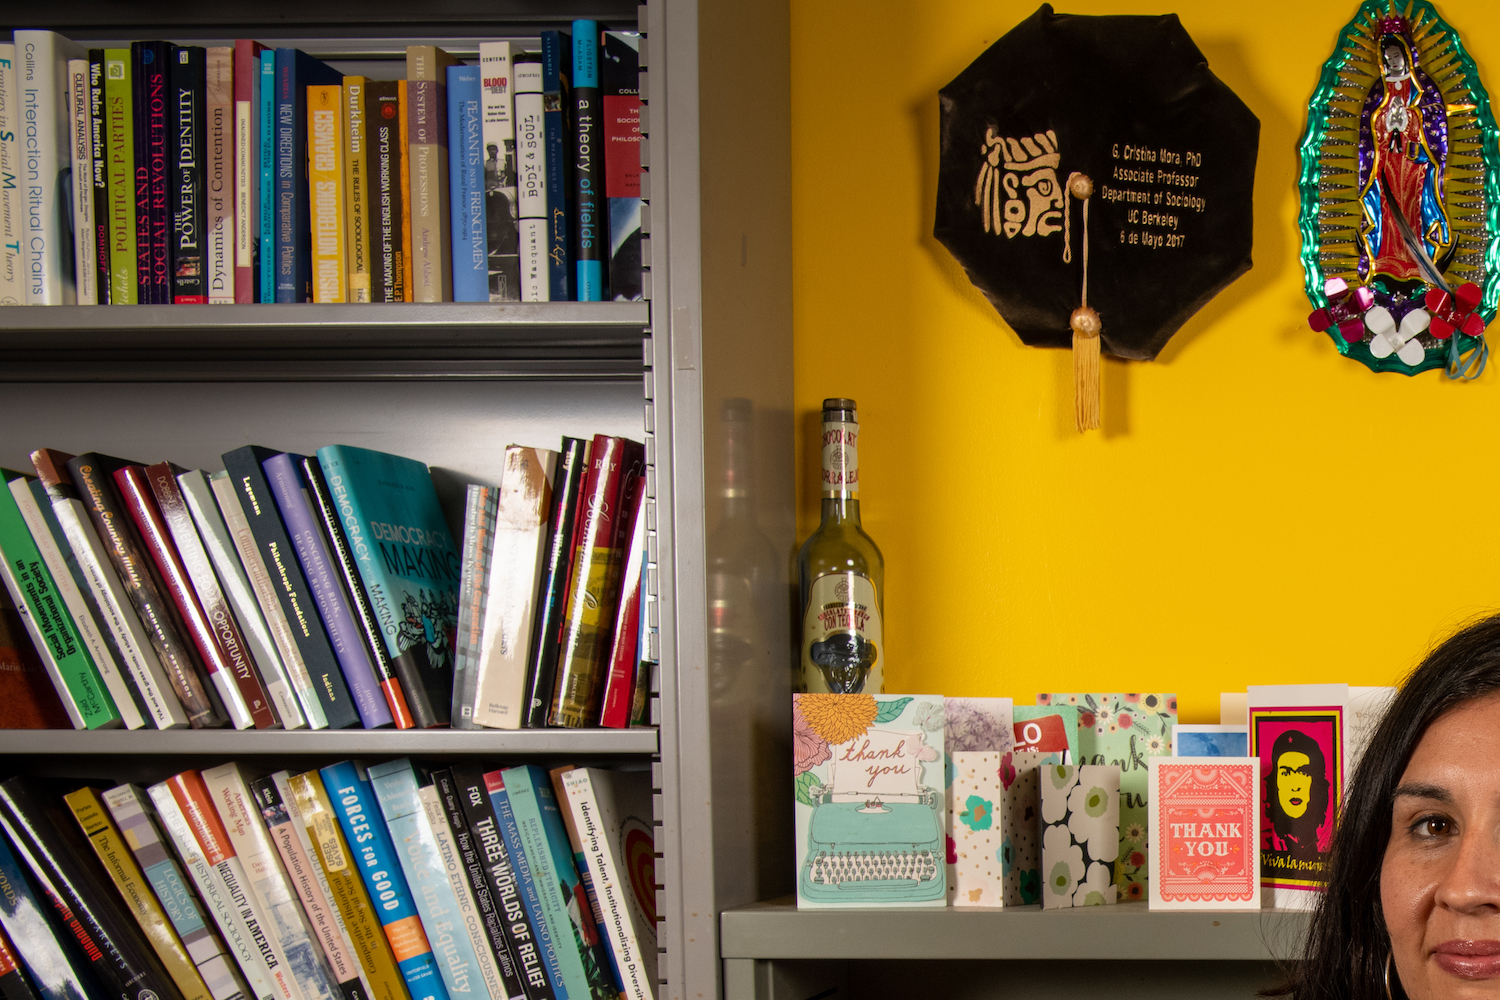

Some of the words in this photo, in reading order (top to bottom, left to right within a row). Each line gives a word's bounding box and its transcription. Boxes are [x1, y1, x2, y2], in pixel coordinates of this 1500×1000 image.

[24, 42, 34, 82] Collins
[482, 56, 507, 64] CENTENO
[484, 78, 508, 88] BLOOD
[578, 99, 590, 110] a
[25, 88, 41, 181] Interaction
[112, 96, 125, 169] PARTIES
[150, 74, 166, 209] REVOLUTIONS
[578, 112, 594, 175] theory
[1114, 165, 1154, 183] Associate
[1158, 169, 1200, 189] Professor
[1124, 144, 1157, 165] Cristina
[1187, 150, 1202, 167] PhD
[28, 185, 43, 231] Ritual
[136, 166, 149, 211] AND
[580, 177, 596, 199] of
[1102, 185, 1152, 206] Department
[1154, 188, 1164, 204] of
[1166, 190, 1207, 213] Sociology
[114, 177, 128, 252] POLITICAL
[582, 202, 596, 251] fields
[1128, 209, 1140, 224] UC
[1142, 209, 1180, 231] Berkeley
[138, 214, 150, 286] STATES
[153, 215, 166, 286] SOCIAL
[1120, 230, 1126, 244] 6
[1130, 231, 1140, 245] de
[1142, 232, 1164, 250] Mayo
[1166, 234, 1186, 248] 2017
[30, 236, 44, 295] Chains
[330, 475, 371, 562] DEMOCRACY
[370, 584, 398, 636] MAKING
[268, 542, 296, 595] Philanthropic
[288, 592, 310, 638] Foundations
[839, 738, 908, 767] thank
[466, 785, 483, 807] FOX
[864, 762, 912, 789] you
[338, 785, 373, 844] FORCES
[363, 846, 378, 868] FOR
[372, 870, 400, 912] GOOD
[476, 816, 496, 862] THREE
[1171, 822, 1244, 840] THANK
[1186, 841, 1231, 859] YOU
[154, 880, 184, 924] HISTORY
[163, 868, 190, 903] LOGICS
[185, 904, 198, 920] OF
[491, 862, 523, 922] WORLDS
[579, 801, 601, 851] Identifying
[595, 851, 610, 884] Talent,
[604, 886, 633, 961] Institutionalizing
[512, 922, 527, 943] OF
[518, 943, 547, 989] RELIEF
